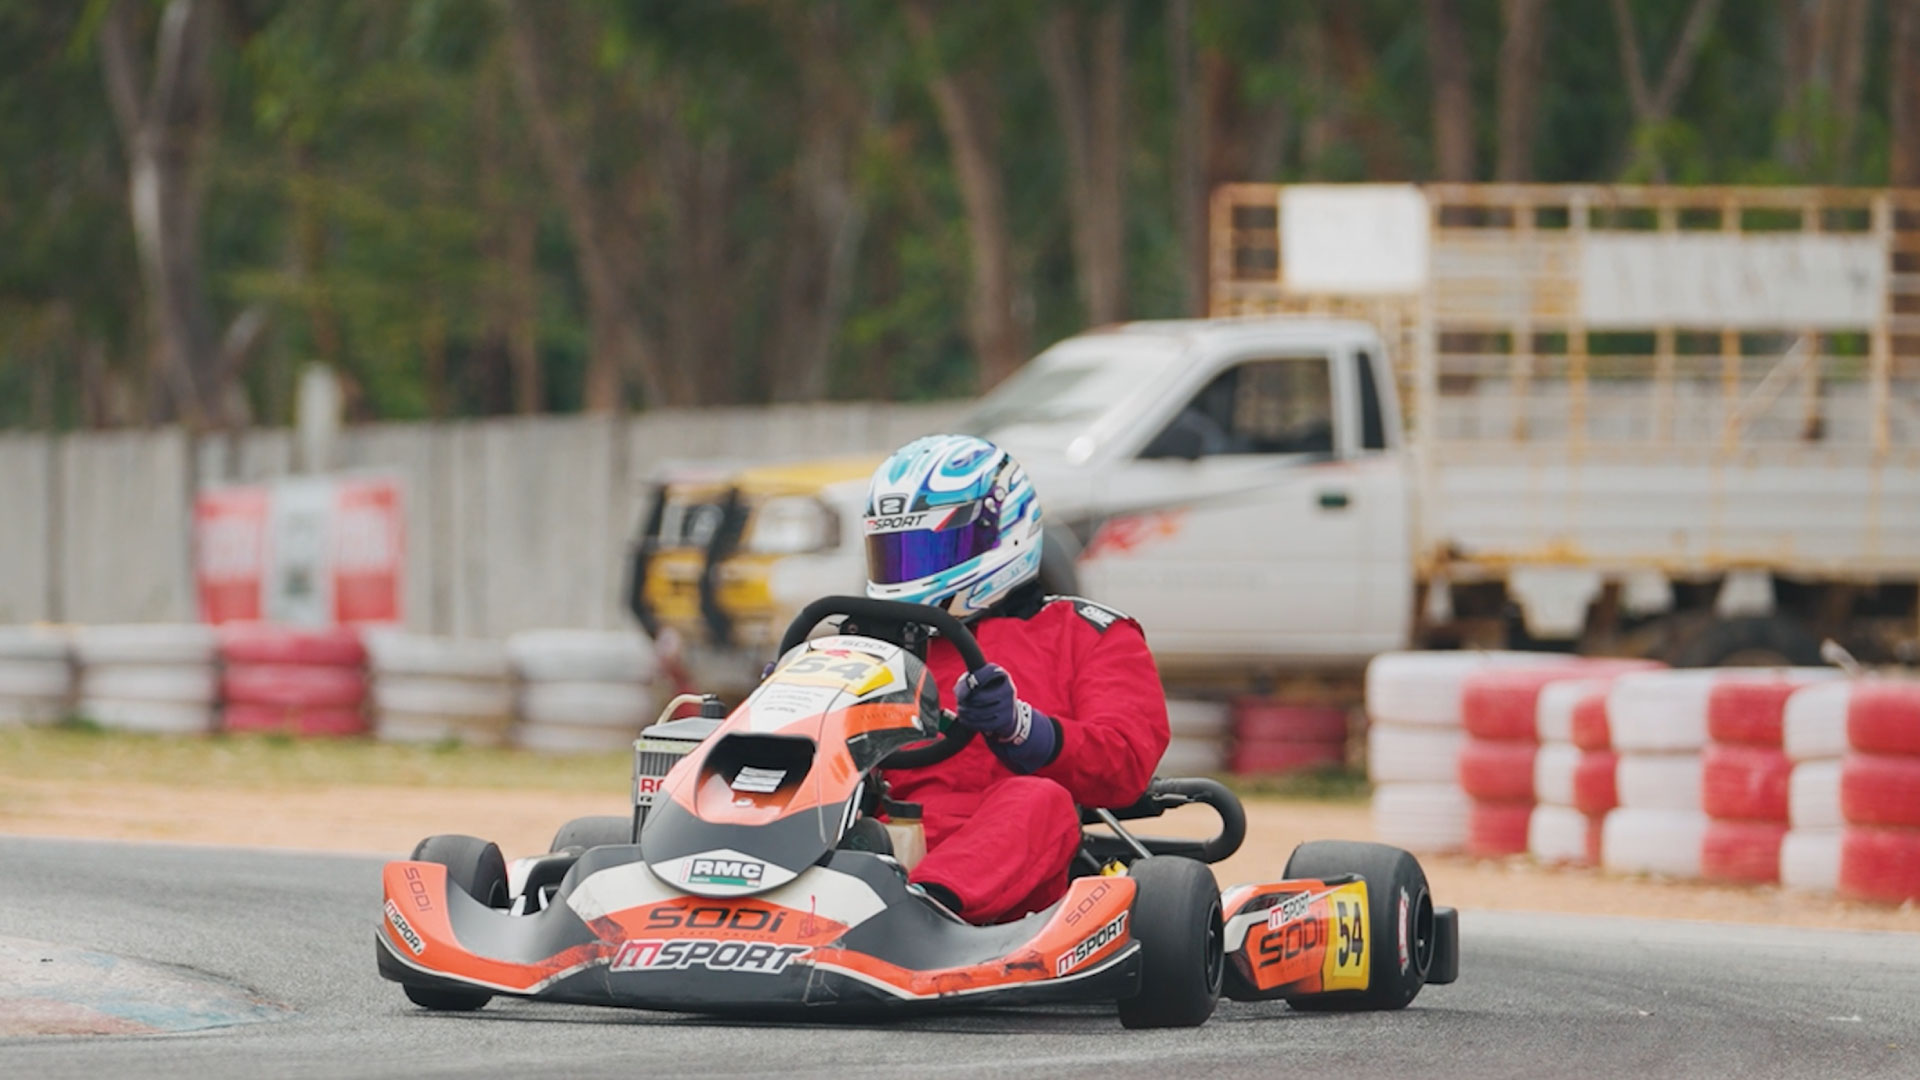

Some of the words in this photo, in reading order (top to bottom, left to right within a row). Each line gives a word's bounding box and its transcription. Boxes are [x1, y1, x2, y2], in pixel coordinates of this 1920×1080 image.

[785, 656, 871, 681] 54
[693, 860, 762, 878] RMC
[1336, 900, 1364, 968] 54
